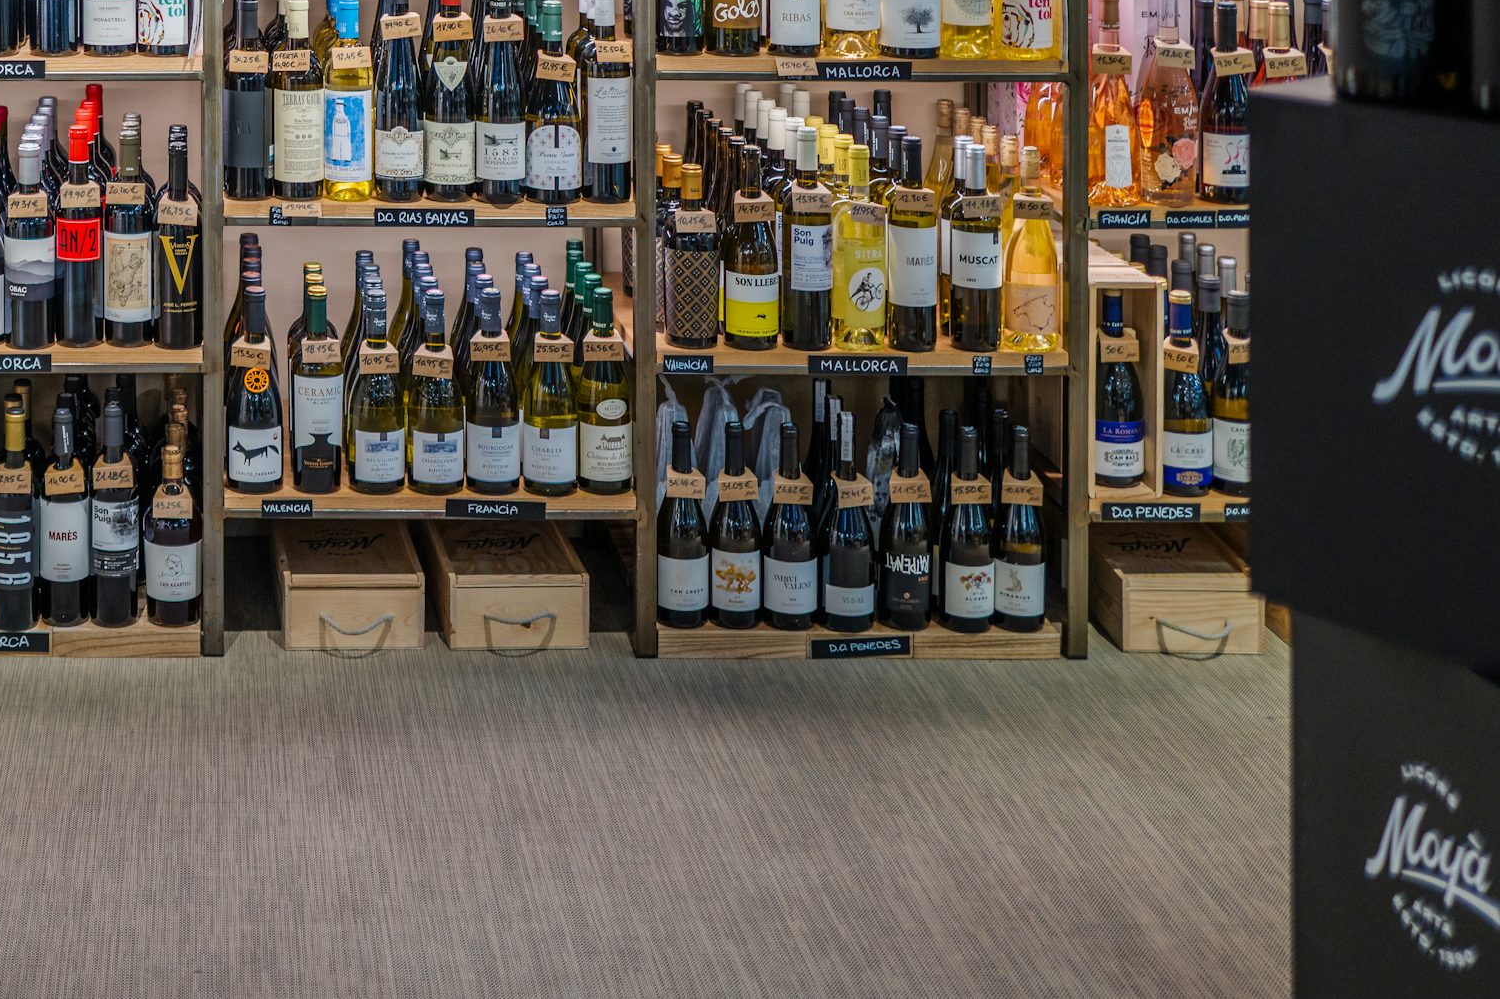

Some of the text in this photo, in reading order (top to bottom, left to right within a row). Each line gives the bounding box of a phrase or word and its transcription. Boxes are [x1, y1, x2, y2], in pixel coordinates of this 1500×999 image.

[782, 12, 811, 22] RIBAS
[826, 66, 900, 78] MALLORCA
[484, 147, 519, 156] 1583
[378, 212, 468, 224] D.O. RIAS BAIXAS
[1180, 215, 1212, 224] CIGALES
[794, 228, 811, 237] Son
[794, 237, 814, 247] Puig
[855, 249, 882, 259] SITRA
[959, 254, 998, 265] MUSCAT
[735, 277, 751, 286] SON
[821, 360, 899, 372] MALLORCA
[531, 446, 562, 454] CHABLIS
[94, 506, 109, 514] Son
[264, 504, 310, 513] VALENCIA
[1112, 506, 1193, 518] D.O. PENEDES
[94, 514, 111, 524] Puig
[49, 531, 78, 542] MARÈS
